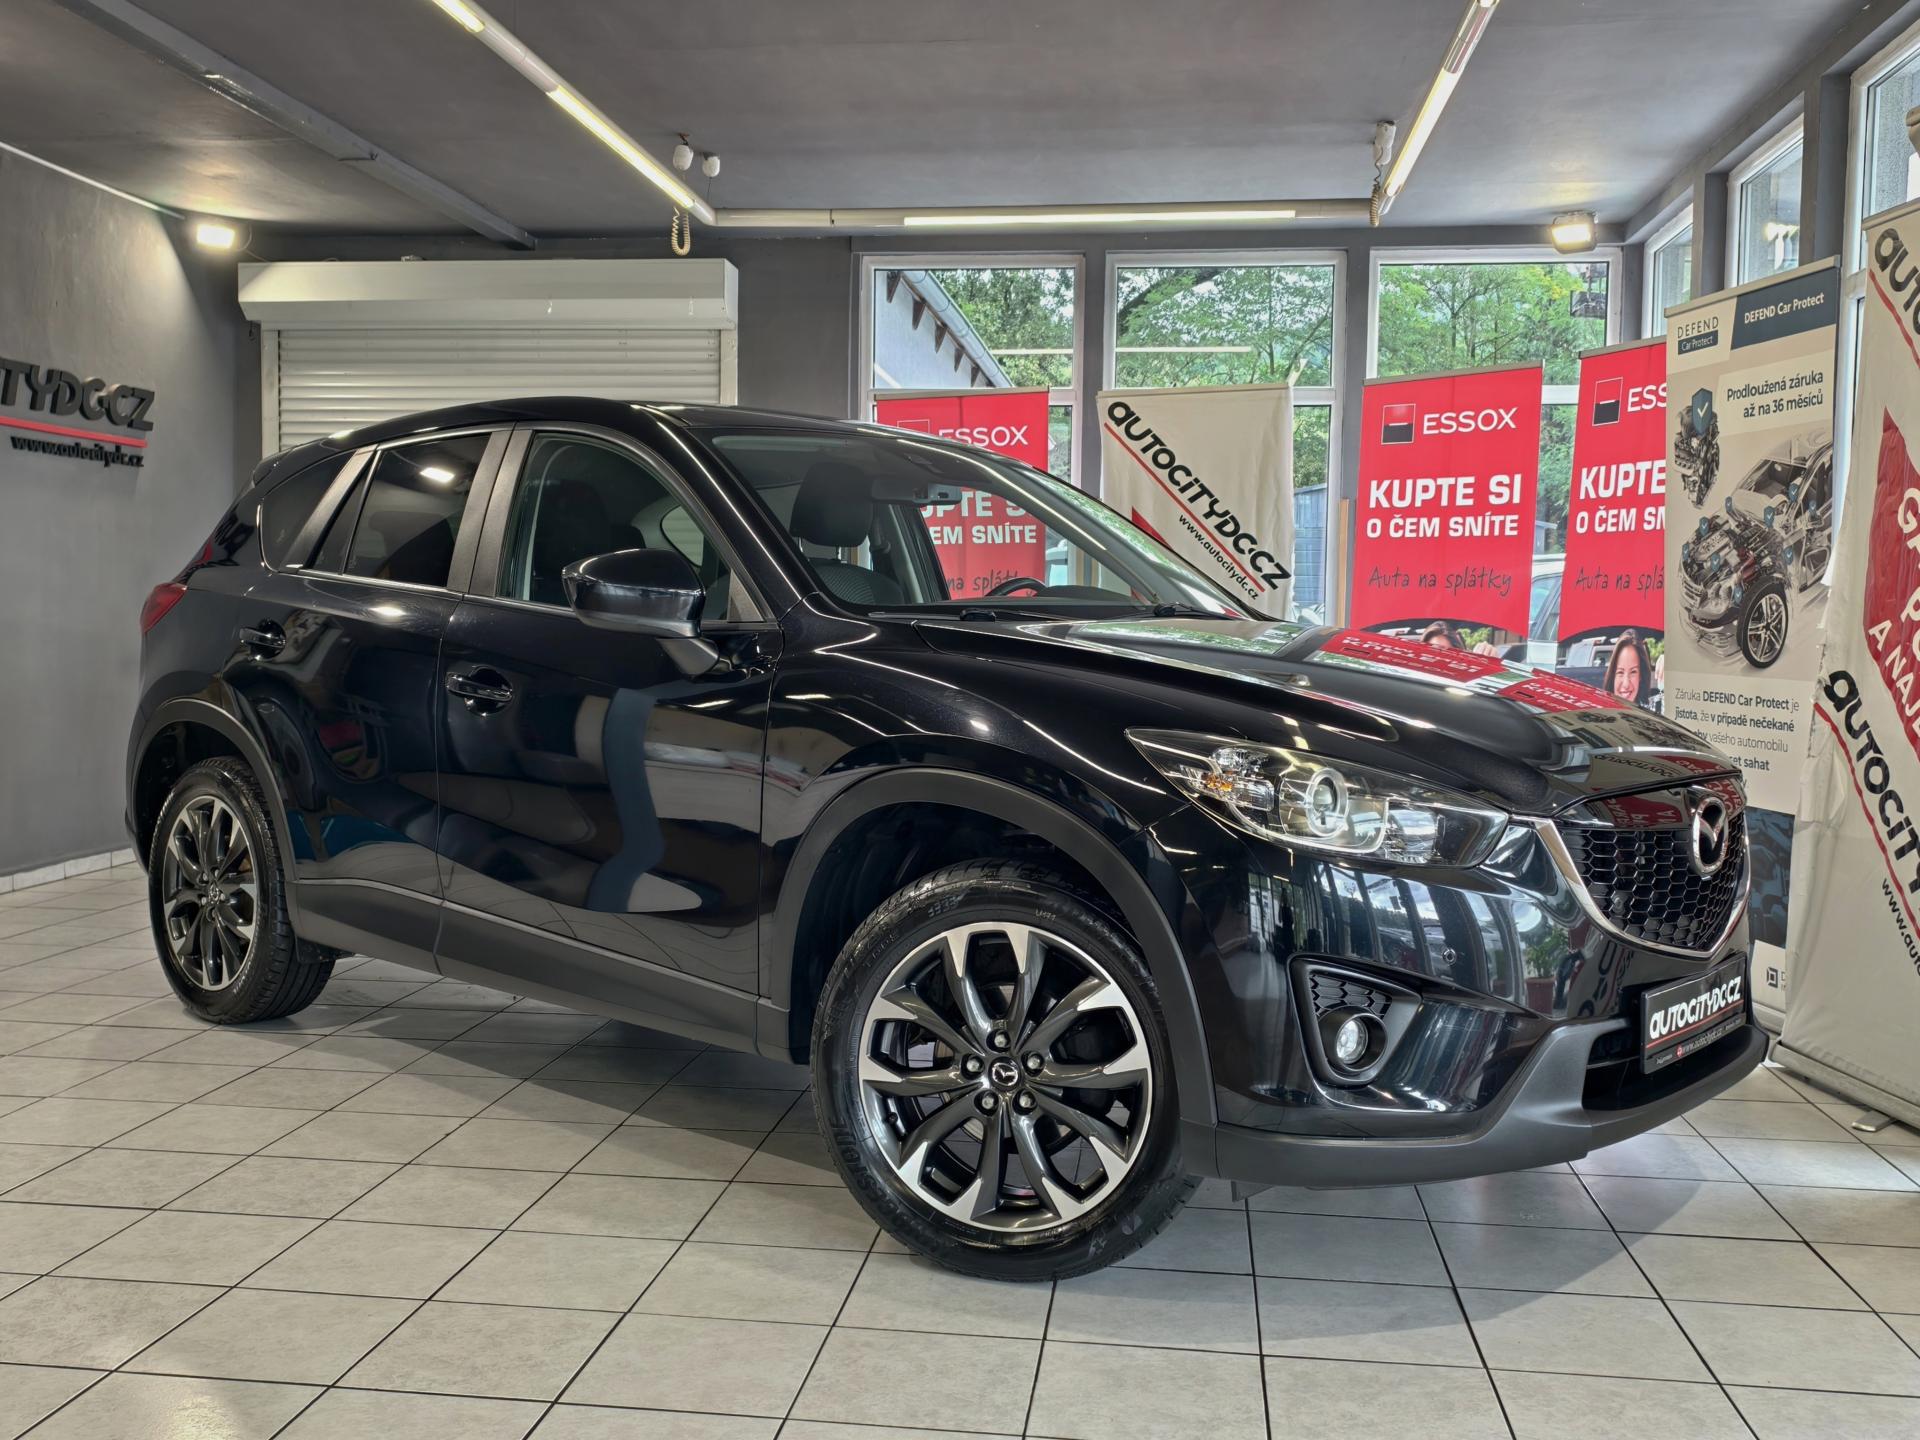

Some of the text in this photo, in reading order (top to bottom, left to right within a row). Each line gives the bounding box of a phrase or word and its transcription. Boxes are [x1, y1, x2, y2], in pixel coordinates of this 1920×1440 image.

[1744, 292, 1825, 325] DEFEND Car Protect
[1677, 316, 1719, 339] DEFEND
[1681, 335, 1714, 352] Car Protect
[1726, 370, 1824, 402] Prodloužená záruka
[1743, 388, 1824, 418] až na 36 měsíců
[1423, 407, 1519, 435] ESSOX
[1369, 473, 1522, 509] KUPTE SI
[1579, 459, 1666, 500] KUPTE
[972, 522, 1038, 545] SNÍTE
[1366, 511, 1519, 538] O ČEM SNÍTE
[1575, 511, 1589, 534] O
[1594, 506, 1637, 533] ČEM
[1178, 514, 1260, 601] www.autocitydc.cz
[1368, 565, 1513, 597] Auta na splátky
[1575, 565, 1609, 592] Auta
[1615, 573, 1630, 589] na
[1675, 688, 1800, 714] Záruka DEFEND Car Protect je
[1700, 711, 1709, 722] že
[1710, 713, 1717, 722] v
[1716, 712, 1748, 727] případě
[1749, 717, 1795, 732] nečekané
[1708, 731, 1736, 746] vašeho
[1737, 737, 1789, 753] automobilu
[1743, 757, 1770, 771] sahat
